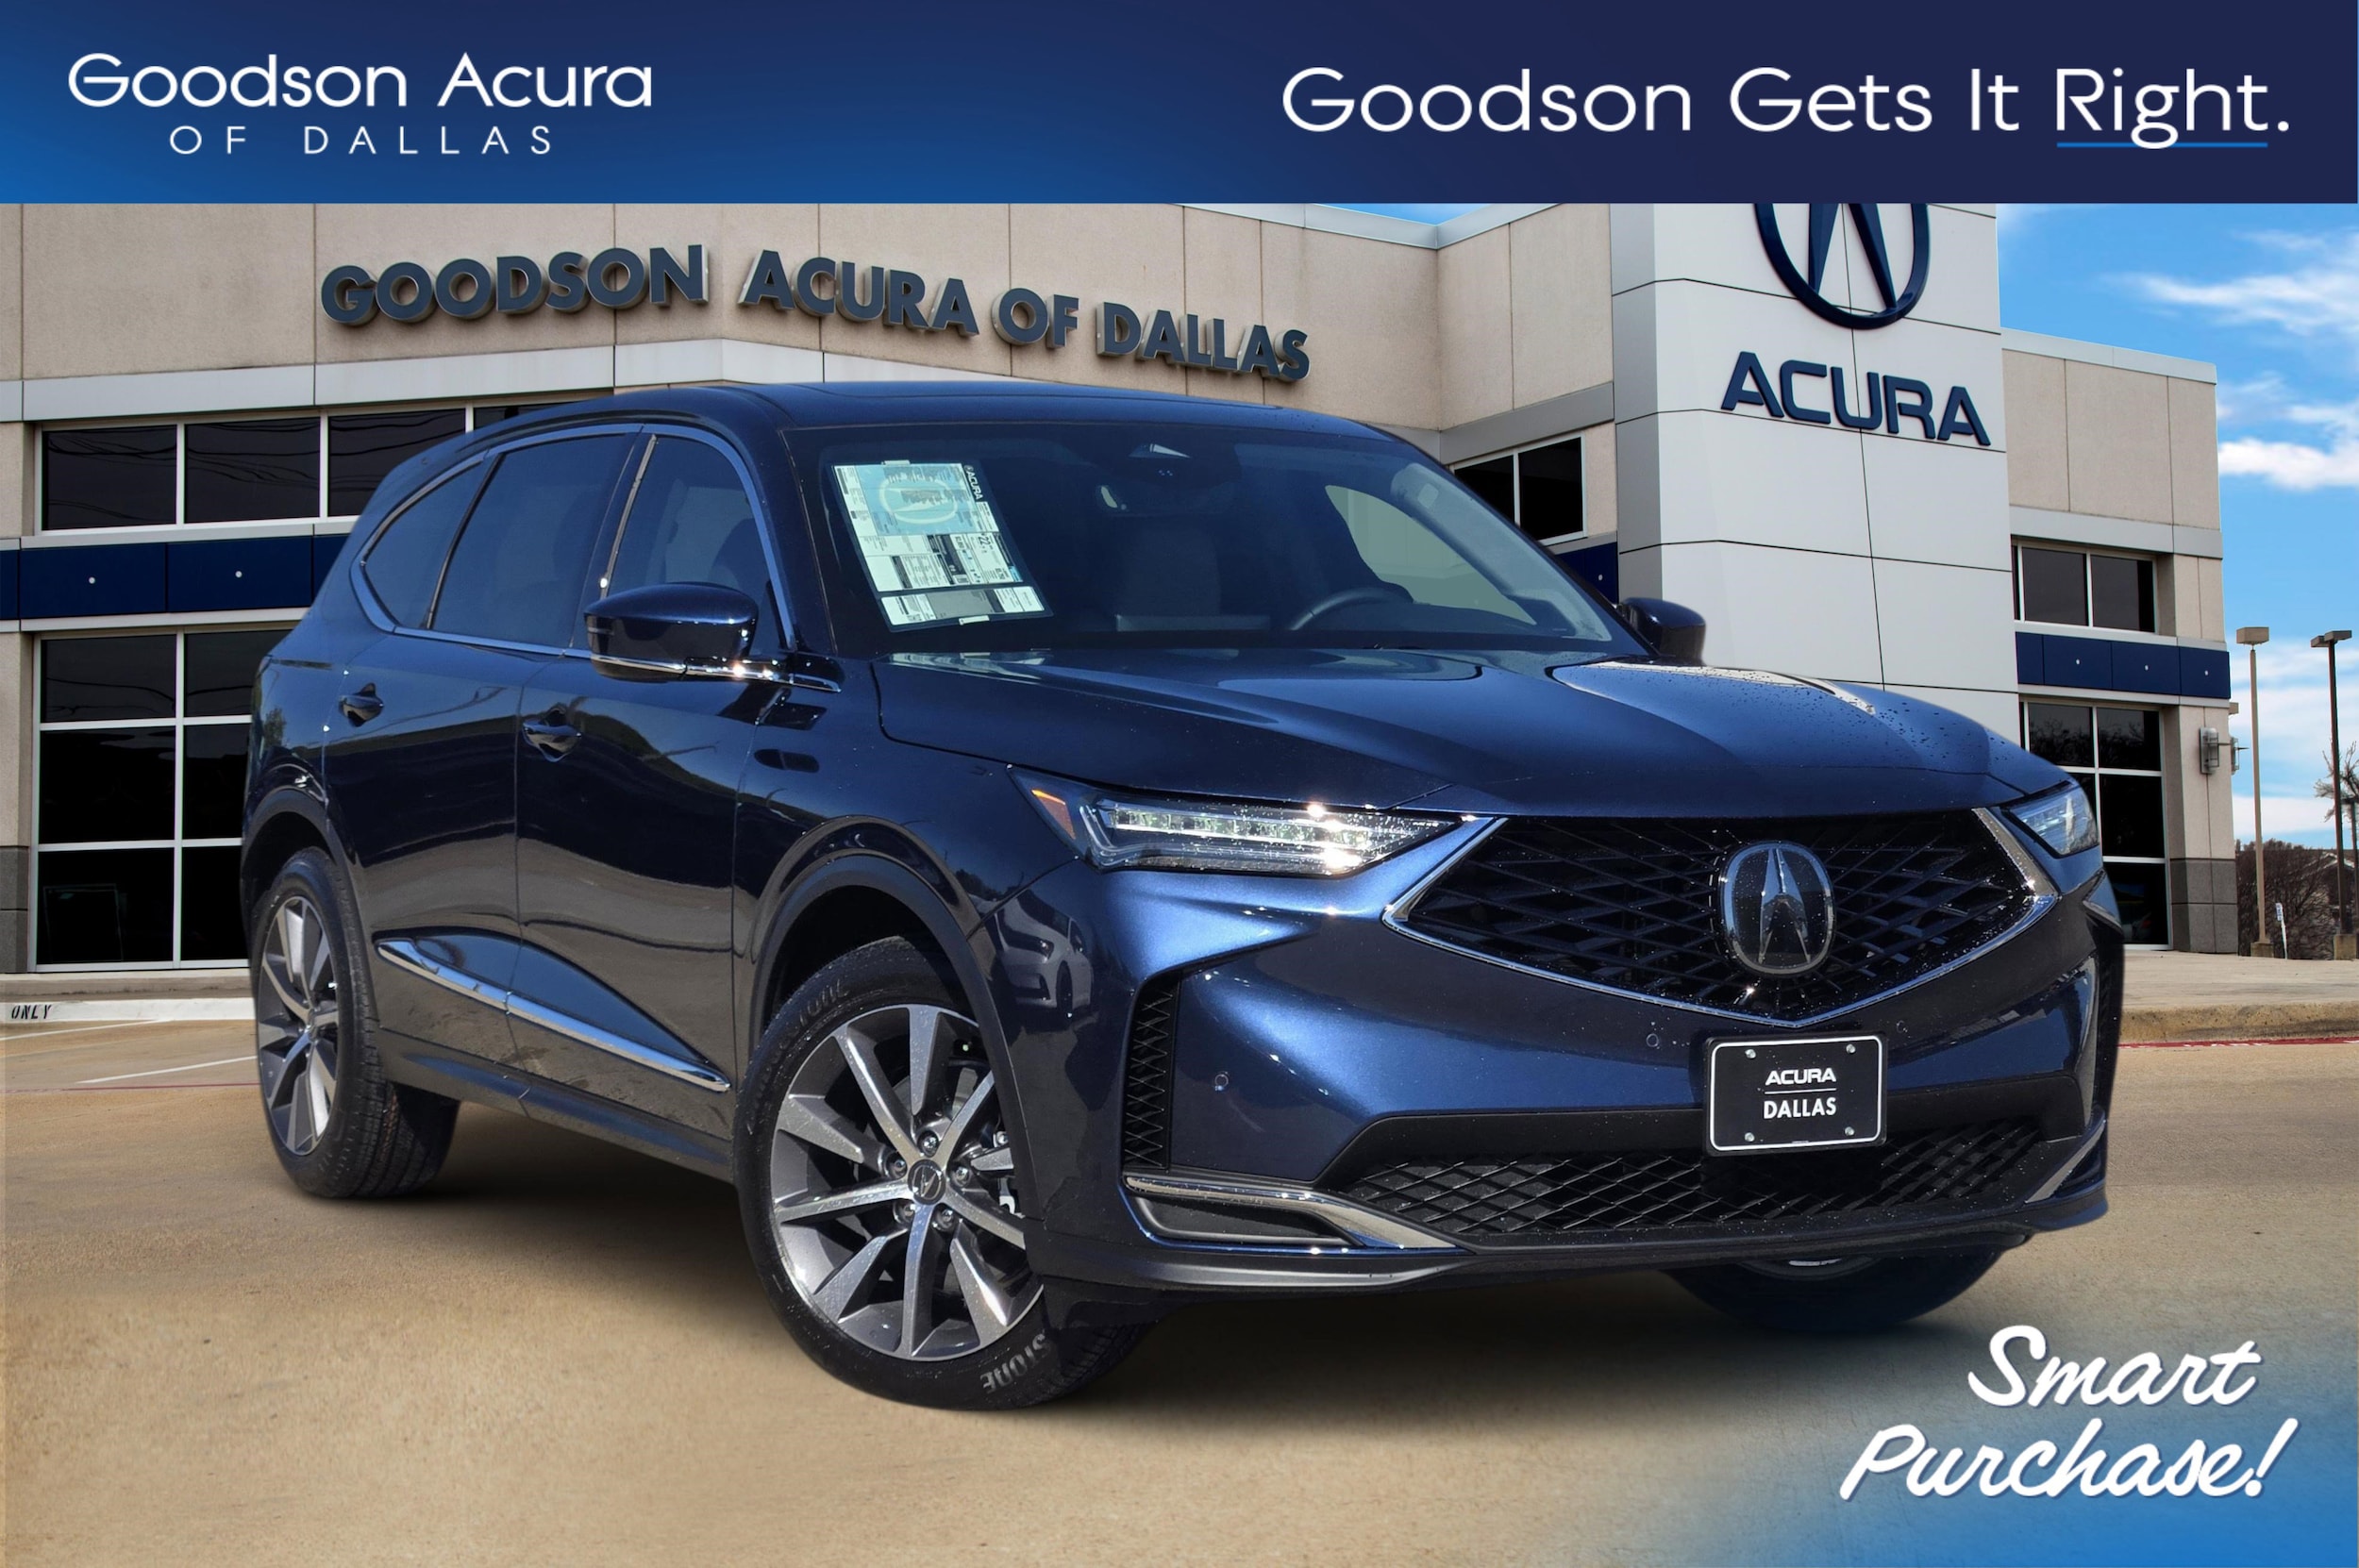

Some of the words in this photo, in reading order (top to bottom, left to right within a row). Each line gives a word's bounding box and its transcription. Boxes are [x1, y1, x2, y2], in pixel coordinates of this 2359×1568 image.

[321, 244, 708, 325] GOODSON
[738, 249, 979, 336] ACURA
[992, 288, 1079, 348] OF
[1096, 302, 1311, 381] DALLAS
[1720, 350, 1991, 446] ACURA
[965, 471, 983, 500] ACURA
[11, 1004, 53, 1019] ONLY
[1765, 1067, 1836, 1086] ACURA
[1763, 1096, 1837, 1120] DALLAS
